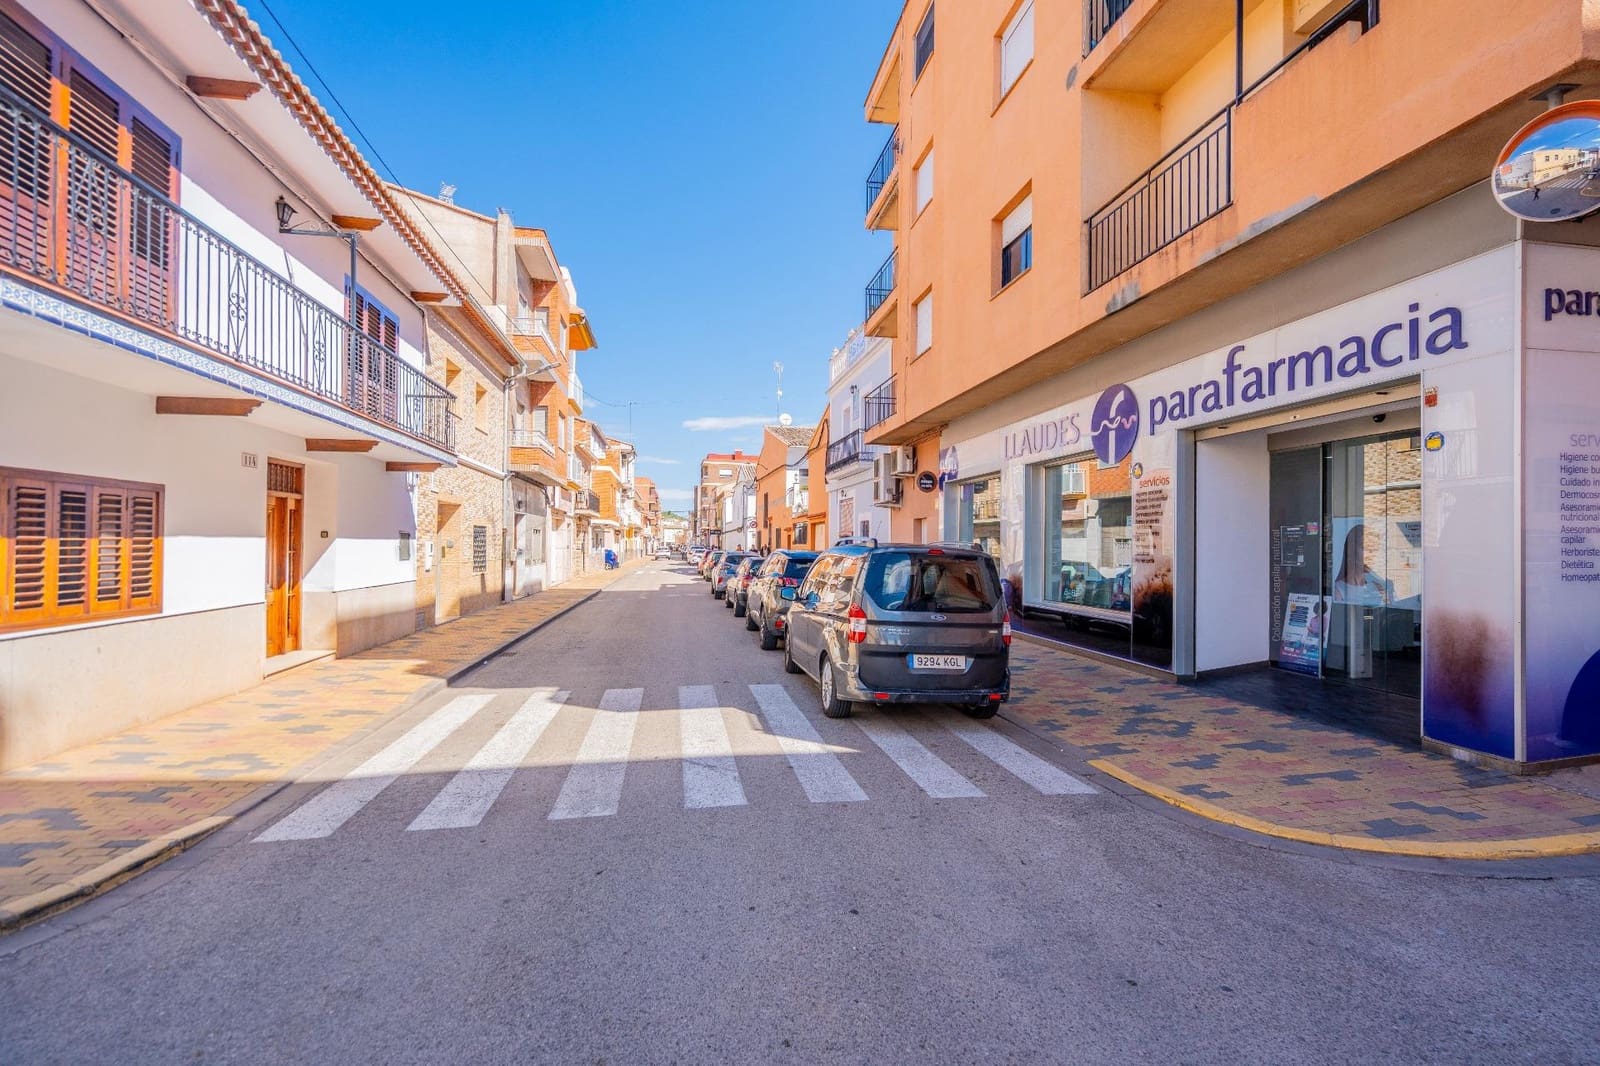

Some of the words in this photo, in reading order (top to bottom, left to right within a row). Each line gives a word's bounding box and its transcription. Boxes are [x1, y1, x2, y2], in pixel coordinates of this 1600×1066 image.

[1544, 287, 1600, 321] par
[1149, 302, 1468, 436] parafarmacia
[1004, 413, 1080, 460] LLAUDES
[1560, 452, 1588, 463] Higiene
[1560, 465, 1589, 475] Higiene
[1560, 477, 1591, 487] Cuidado
[1561, 535, 1585, 546] capilar
[1271, 562, 1282, 593] capilar
[1271, 595, 1281, 642] Coloración
[916, 656, 941, 667] 9294
[943, 657, 962, 667] KGL
